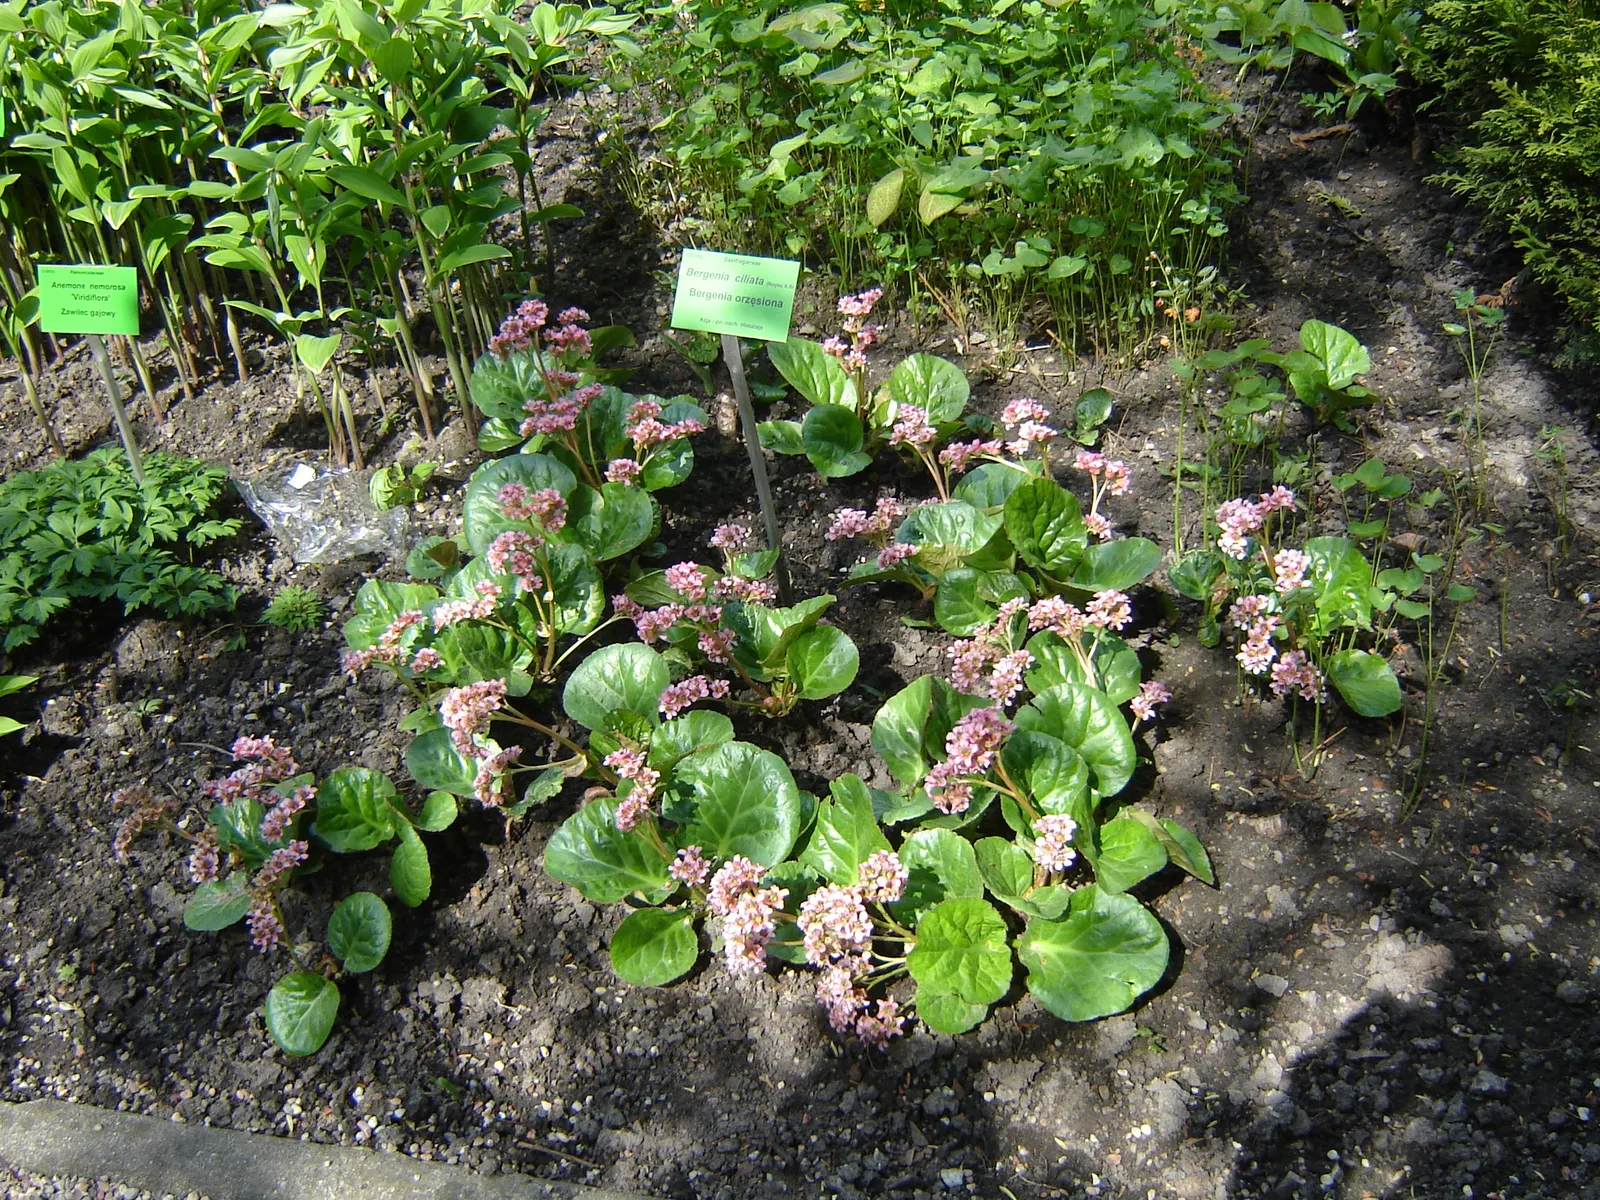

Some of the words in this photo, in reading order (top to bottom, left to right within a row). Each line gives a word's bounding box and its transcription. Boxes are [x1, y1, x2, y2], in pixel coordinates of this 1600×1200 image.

[686, 267, 730, 281] Bergenia
[735, 273, 765, 286] ciliata
[51, 281, 86, 289] Anemone
[89, 282, 126, 291] nemorosa
[689, 287, 732, 302] Bergenia
[735, 294, 784, 309] orzęsiona
[61, 308, 88, 316] Zawilec
[90, 309, 116, 318] gajowy
